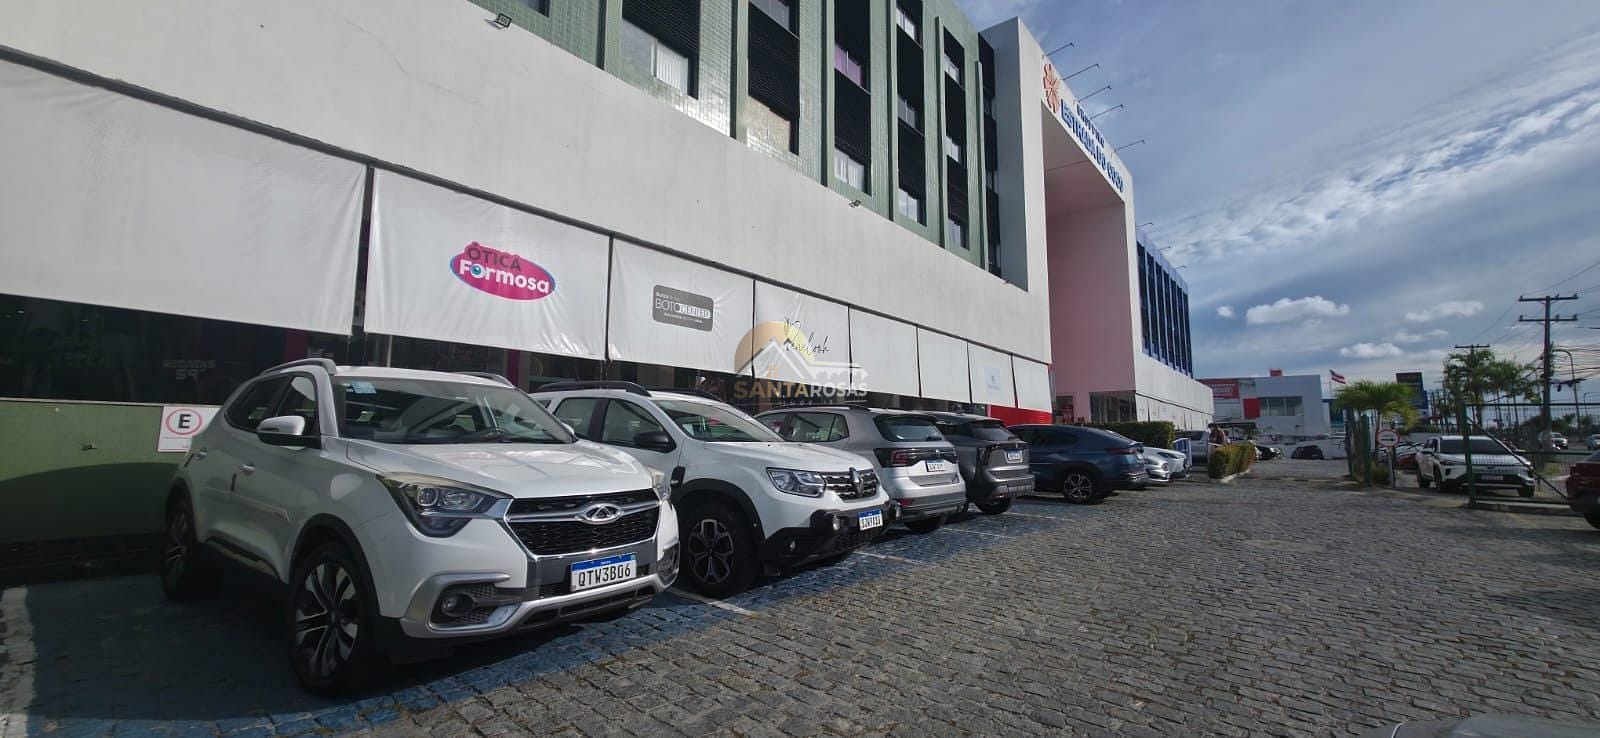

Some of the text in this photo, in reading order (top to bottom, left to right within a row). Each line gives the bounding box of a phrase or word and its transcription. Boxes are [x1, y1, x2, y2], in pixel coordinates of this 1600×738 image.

[459, 259, 550, 294] Formosa
[178, 413, 192, 429] E
[578, 562, 631, 587] QTW3B06
